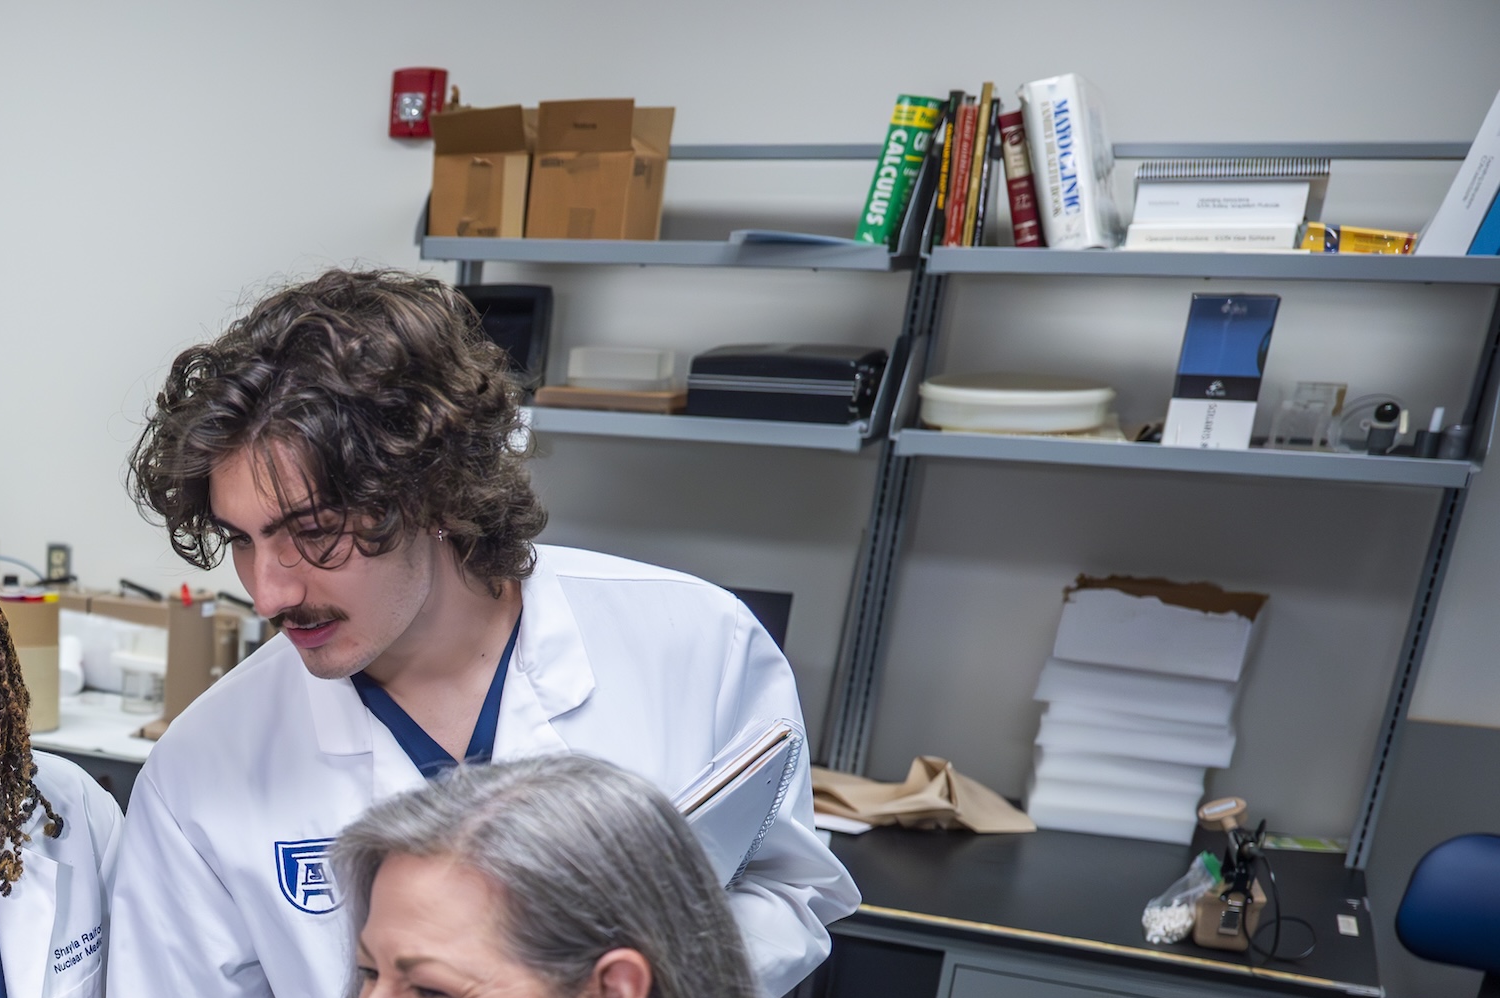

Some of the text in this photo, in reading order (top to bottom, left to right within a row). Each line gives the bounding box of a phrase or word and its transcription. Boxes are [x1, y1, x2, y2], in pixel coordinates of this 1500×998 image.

[1052, 100, 1073, 149] MAYO
[866, 129, 908, 227] CALCULUS
[1059, 151, 1081, 215] CLINIC
[53, 951, 84, 974] Nuclear
[54, 924, 102, 960] Shayla Raifo
